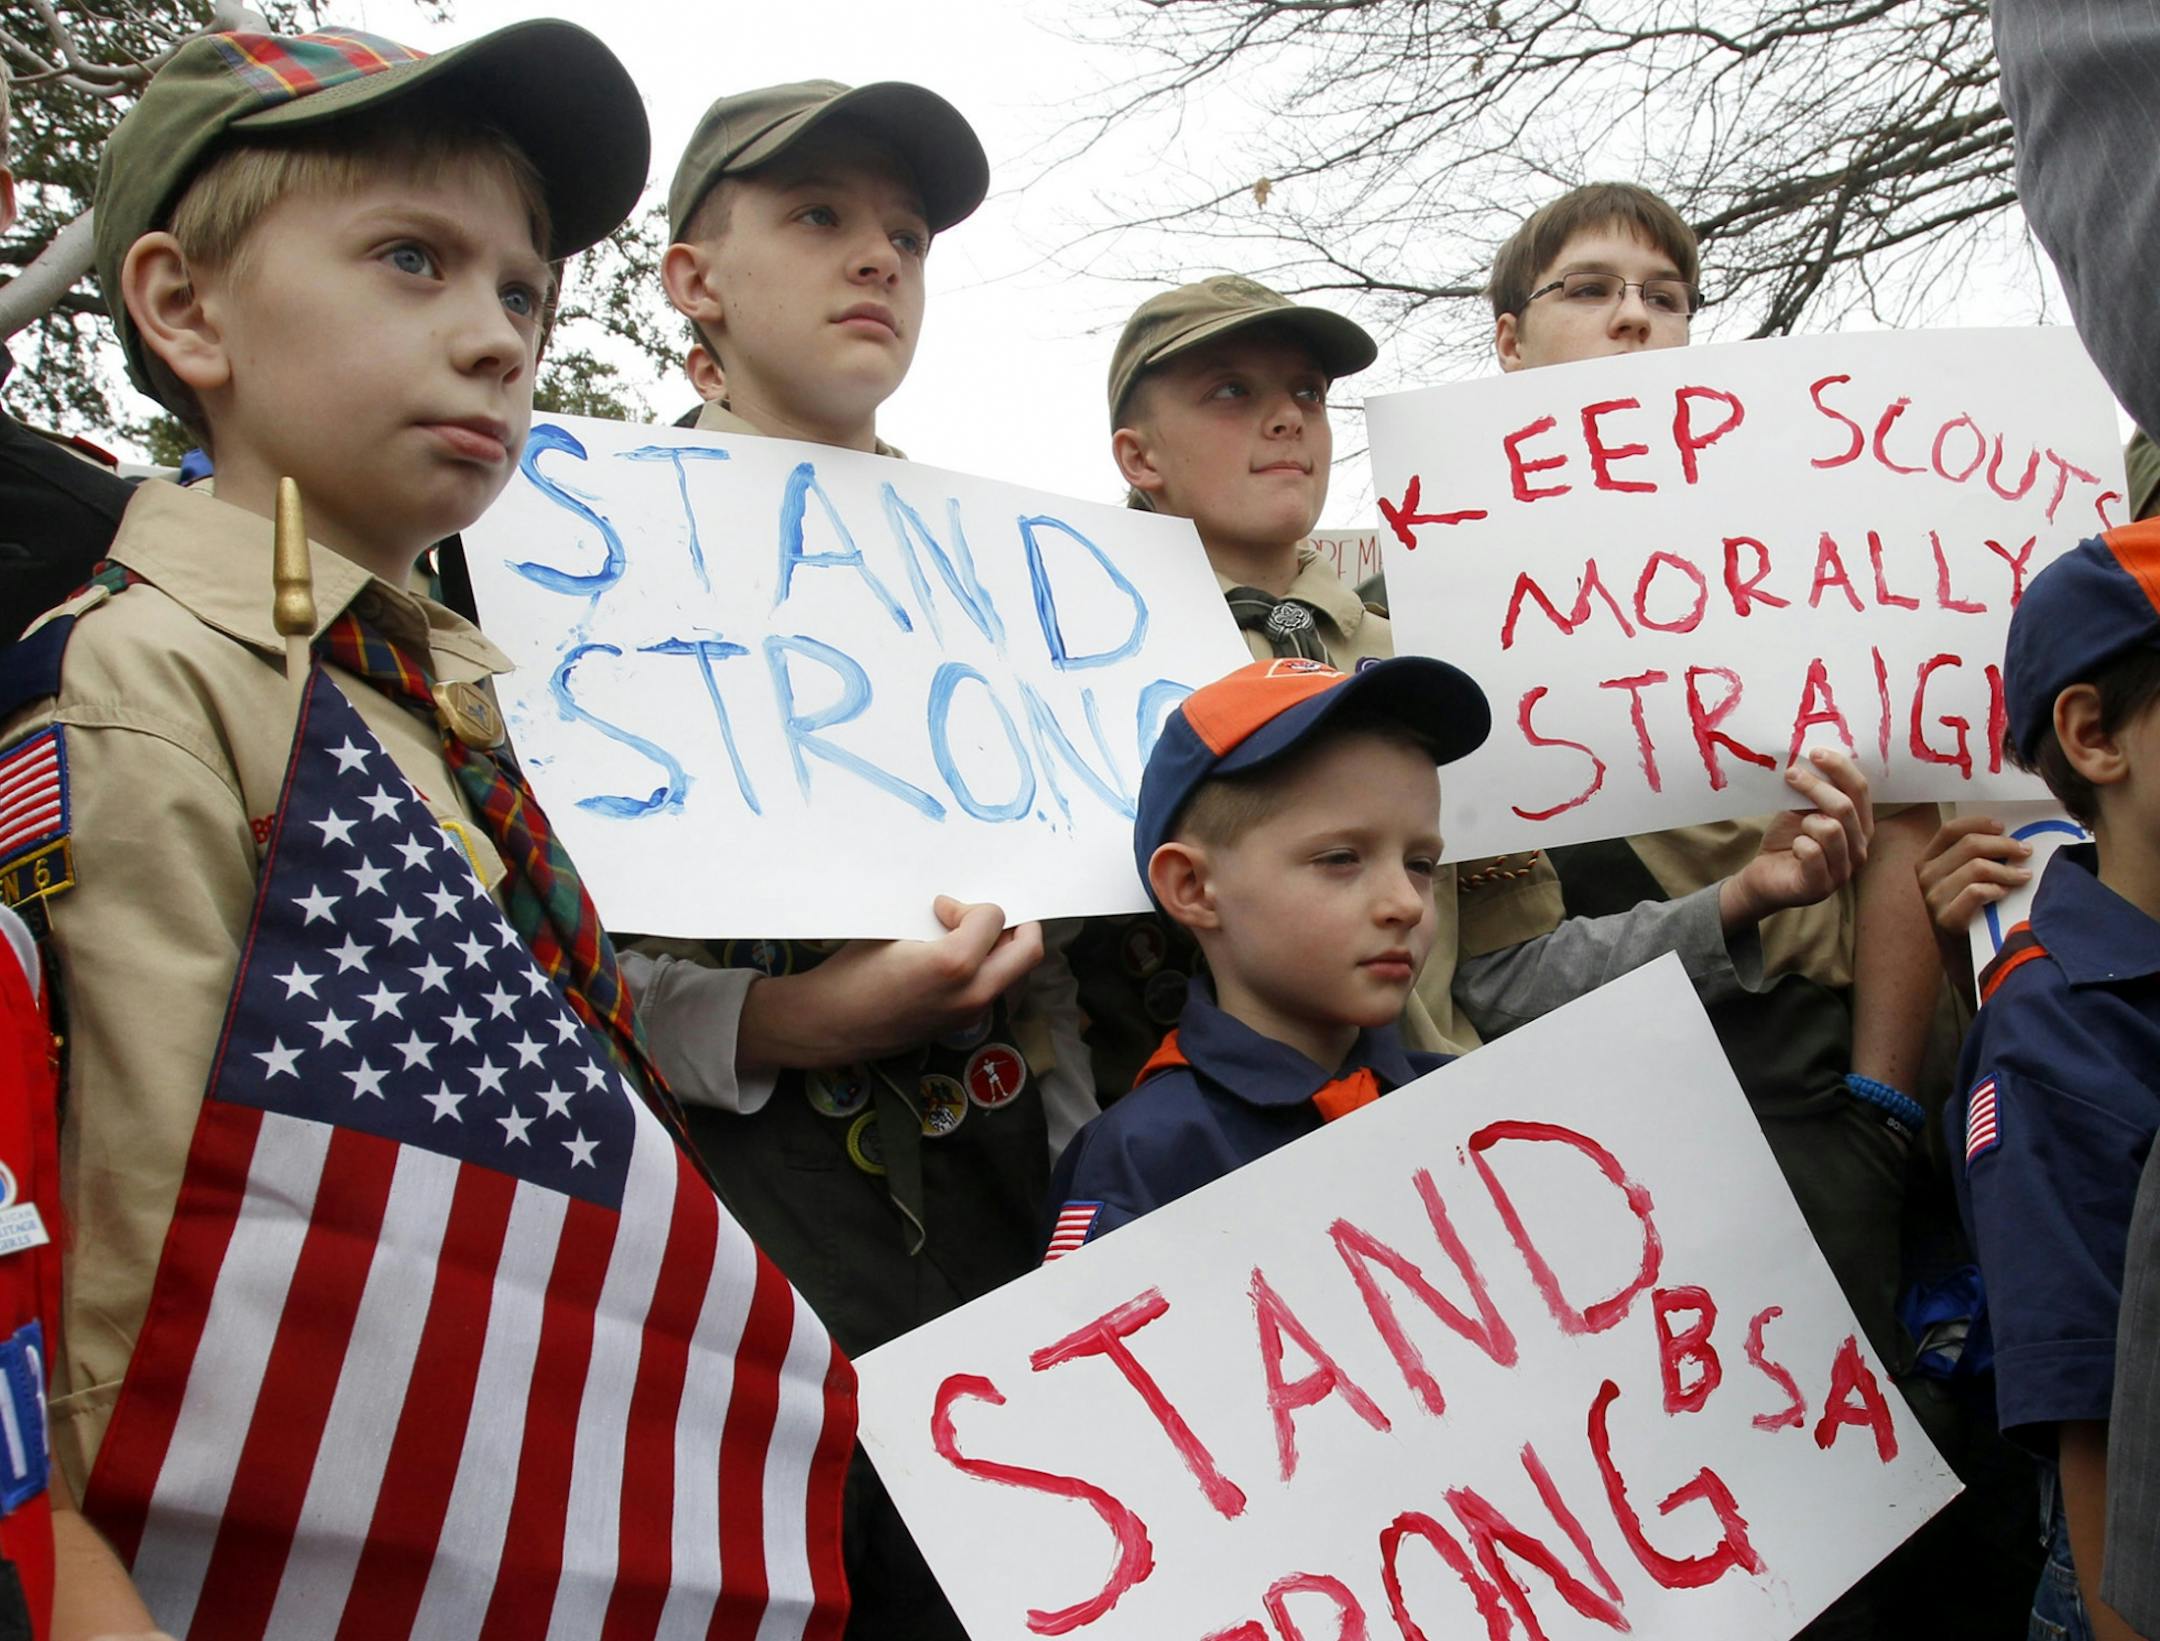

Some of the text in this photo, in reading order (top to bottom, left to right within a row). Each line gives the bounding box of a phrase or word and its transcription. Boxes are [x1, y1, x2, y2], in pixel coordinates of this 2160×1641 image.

[505, 423, 1149, 672] STAND
[1378, 386, 1745, 551] KEEP
[1500, 530, 2036, 650] MORALLY
[1511, 646, 2008, 822] STRAIG
[931, 1119, 1663, 1635] STAND
[1651, 1287, 1900, 1464] BSA
